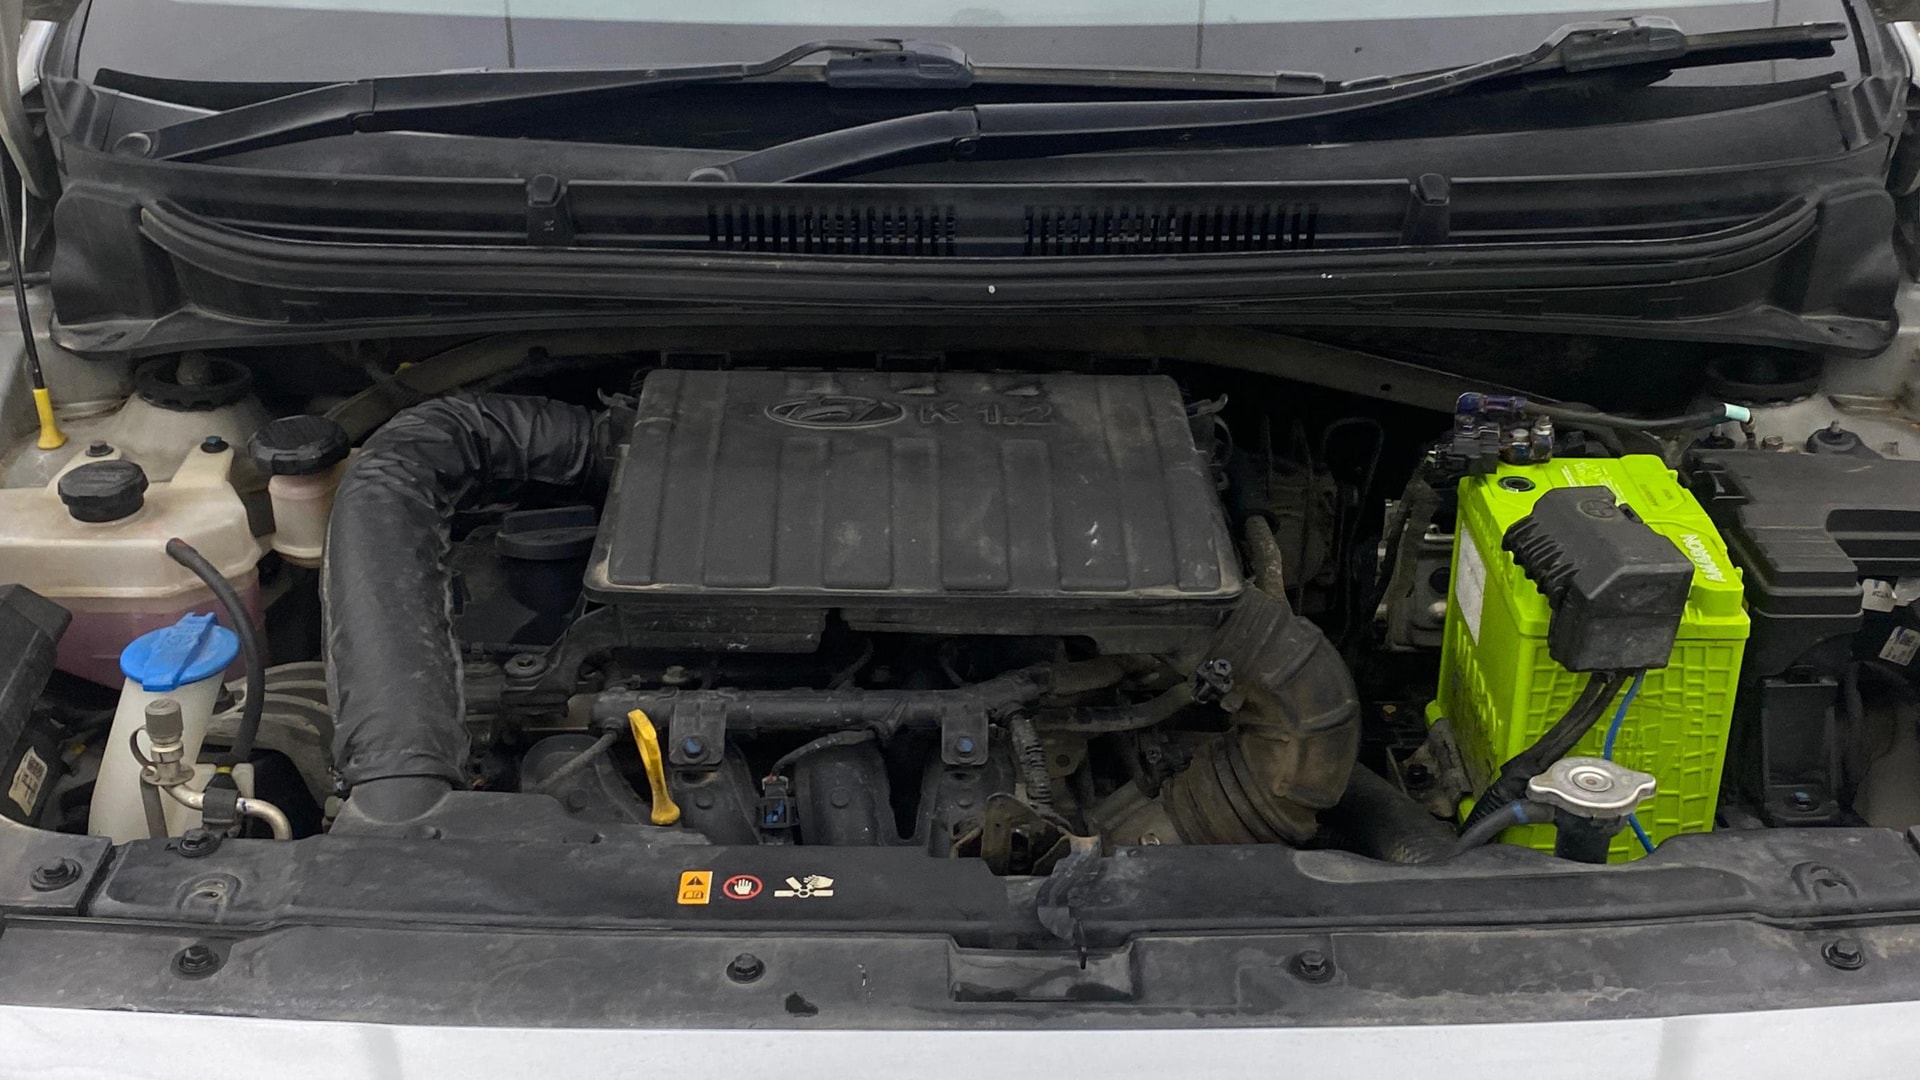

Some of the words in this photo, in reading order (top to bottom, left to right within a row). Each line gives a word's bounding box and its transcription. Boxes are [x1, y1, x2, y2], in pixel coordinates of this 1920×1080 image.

[919, 403, 962, 424] K
[977, 403, 1055, 426] 1.2
[1679, 533, 1727, 582] AMARON
